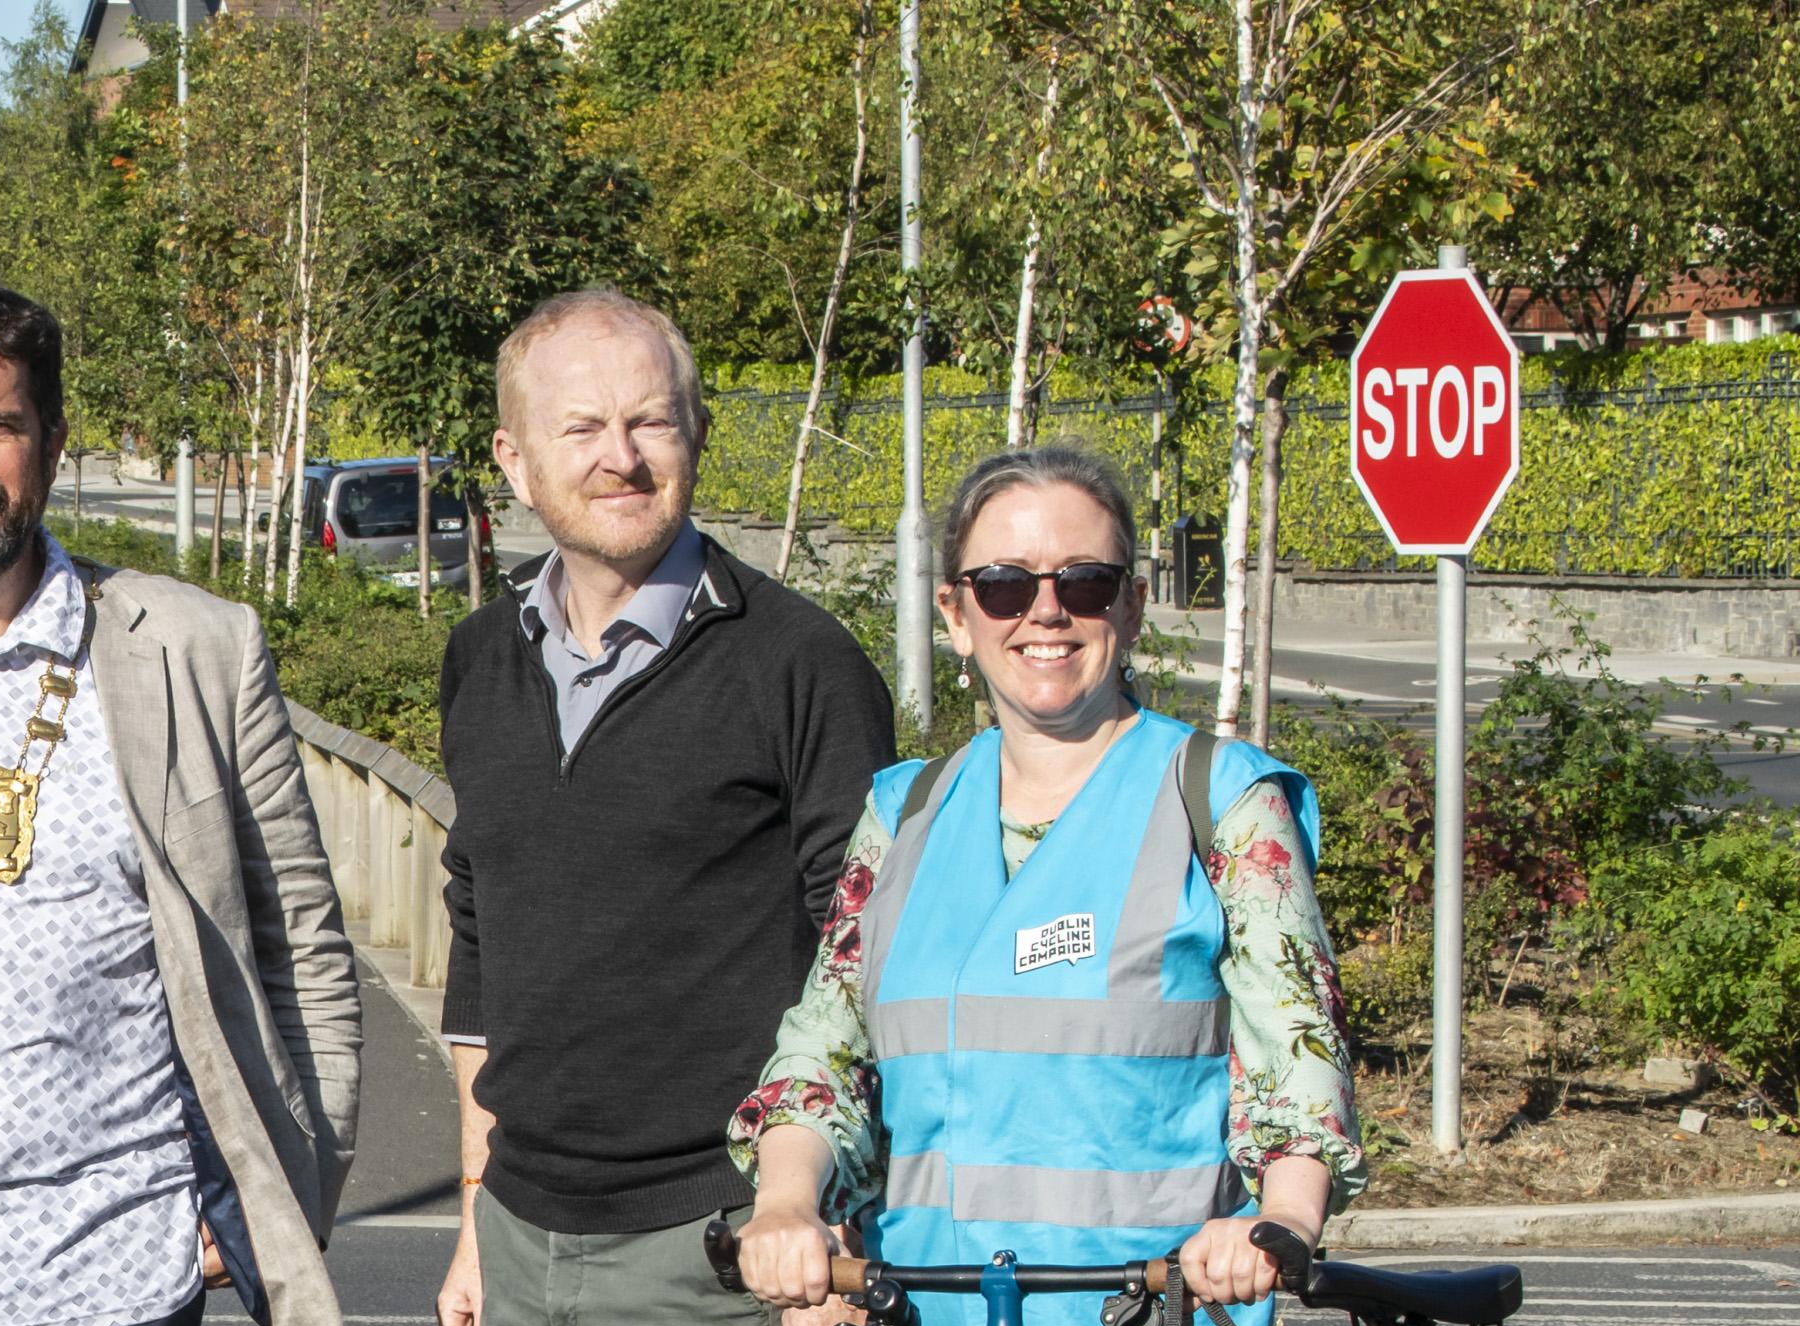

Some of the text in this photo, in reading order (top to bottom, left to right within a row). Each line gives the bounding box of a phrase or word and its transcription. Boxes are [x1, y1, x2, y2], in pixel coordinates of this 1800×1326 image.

[1362, 364, 1506, 461] STOP
[1041, 917, 1090, 938] DUBLIN
[1031, 930, 1090, 952] CYCLING
[1019, 942, 1091, 968] CAMPAIGN
